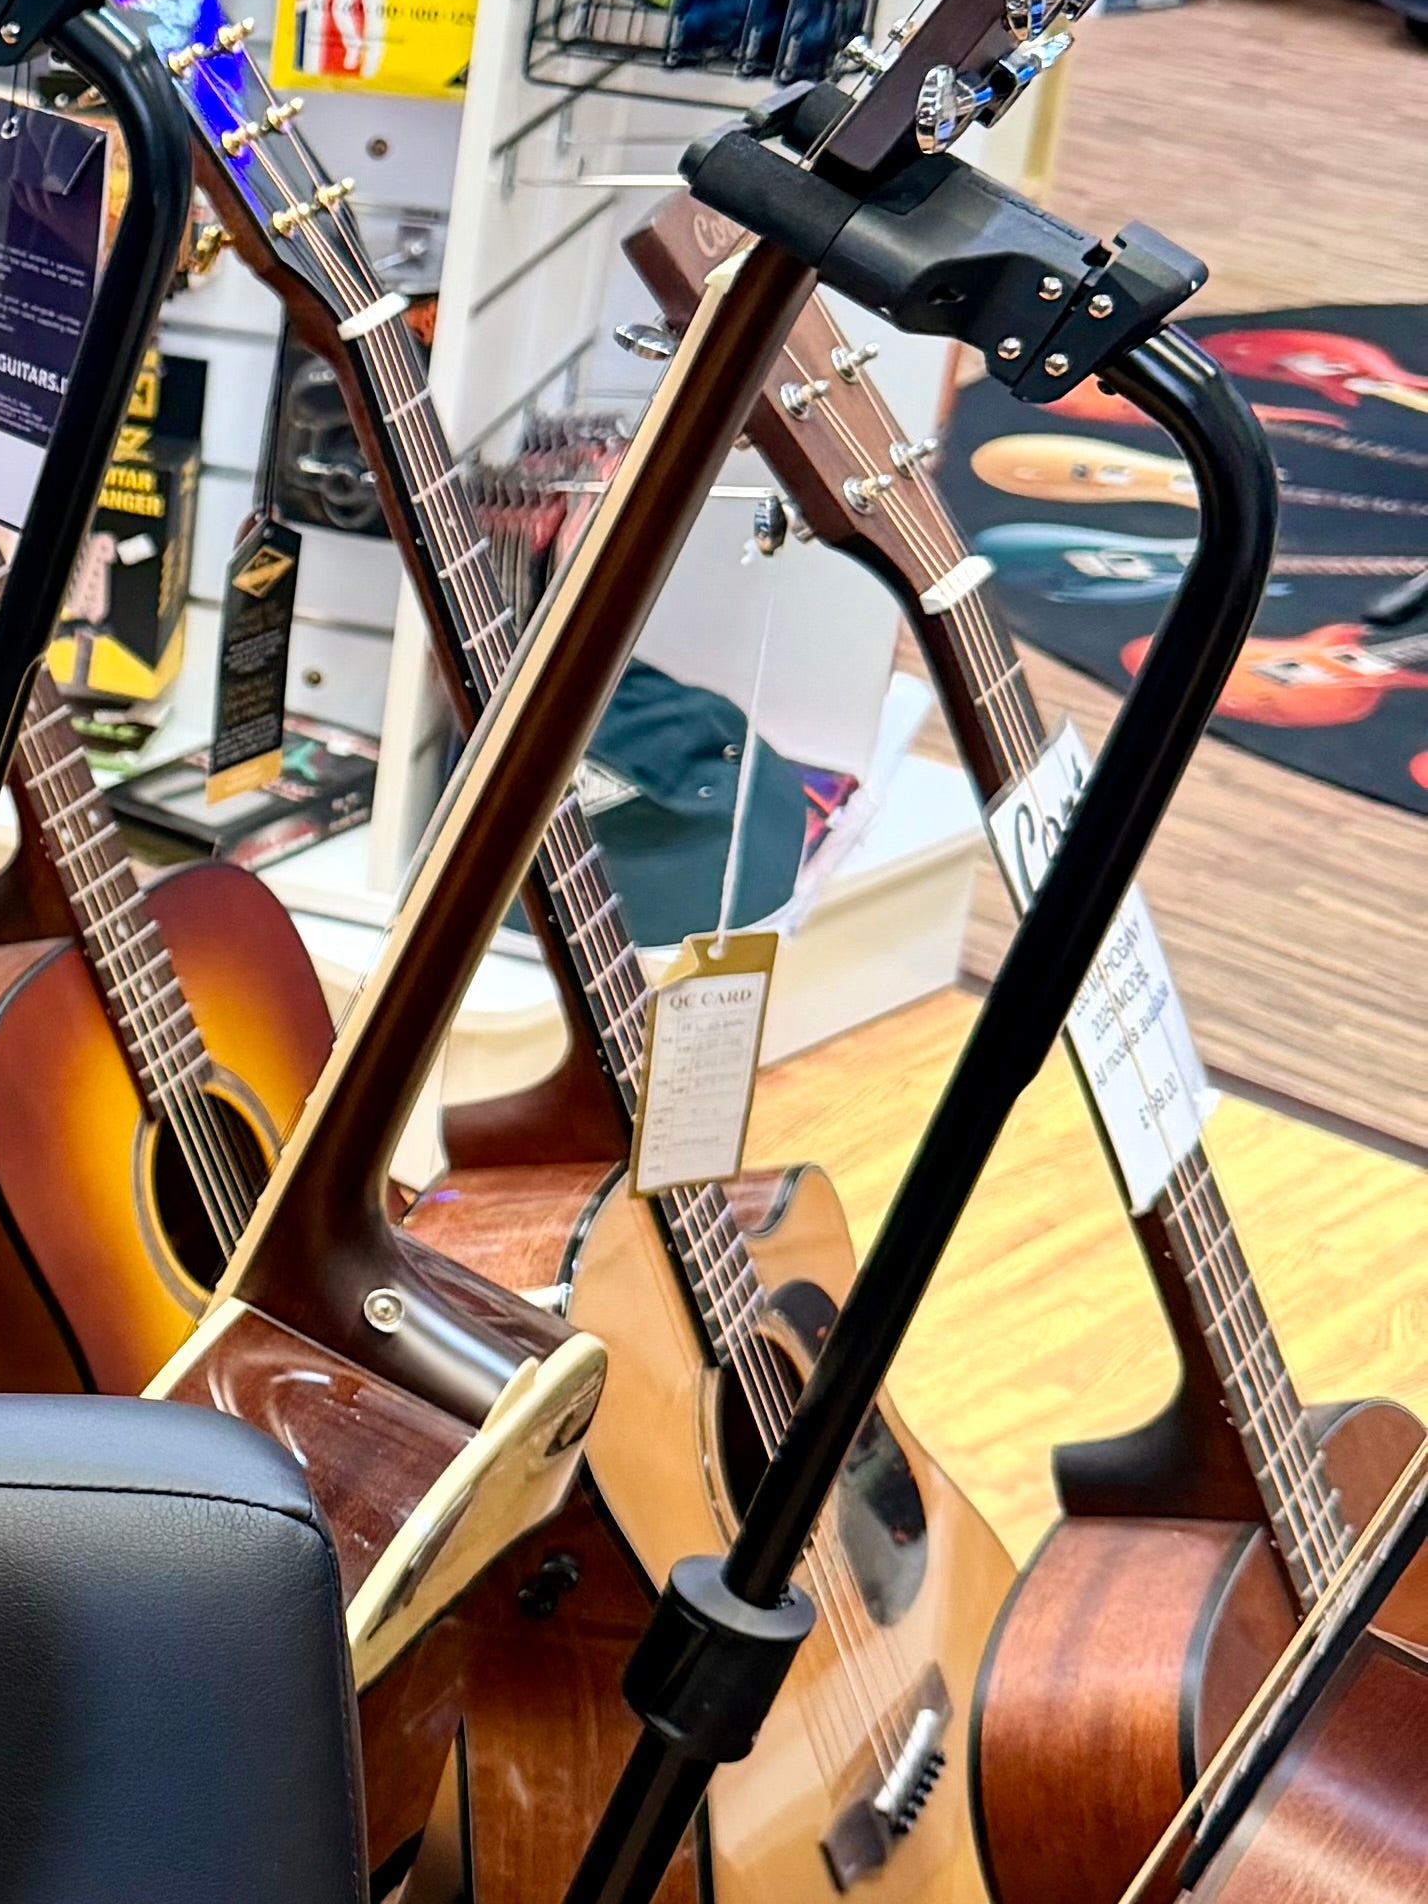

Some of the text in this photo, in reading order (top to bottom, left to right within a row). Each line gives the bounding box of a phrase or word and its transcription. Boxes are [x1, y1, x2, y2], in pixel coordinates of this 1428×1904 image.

[98, 487, 165, 518] ANGER
[670, 988, 753, 1011] QC CARD
